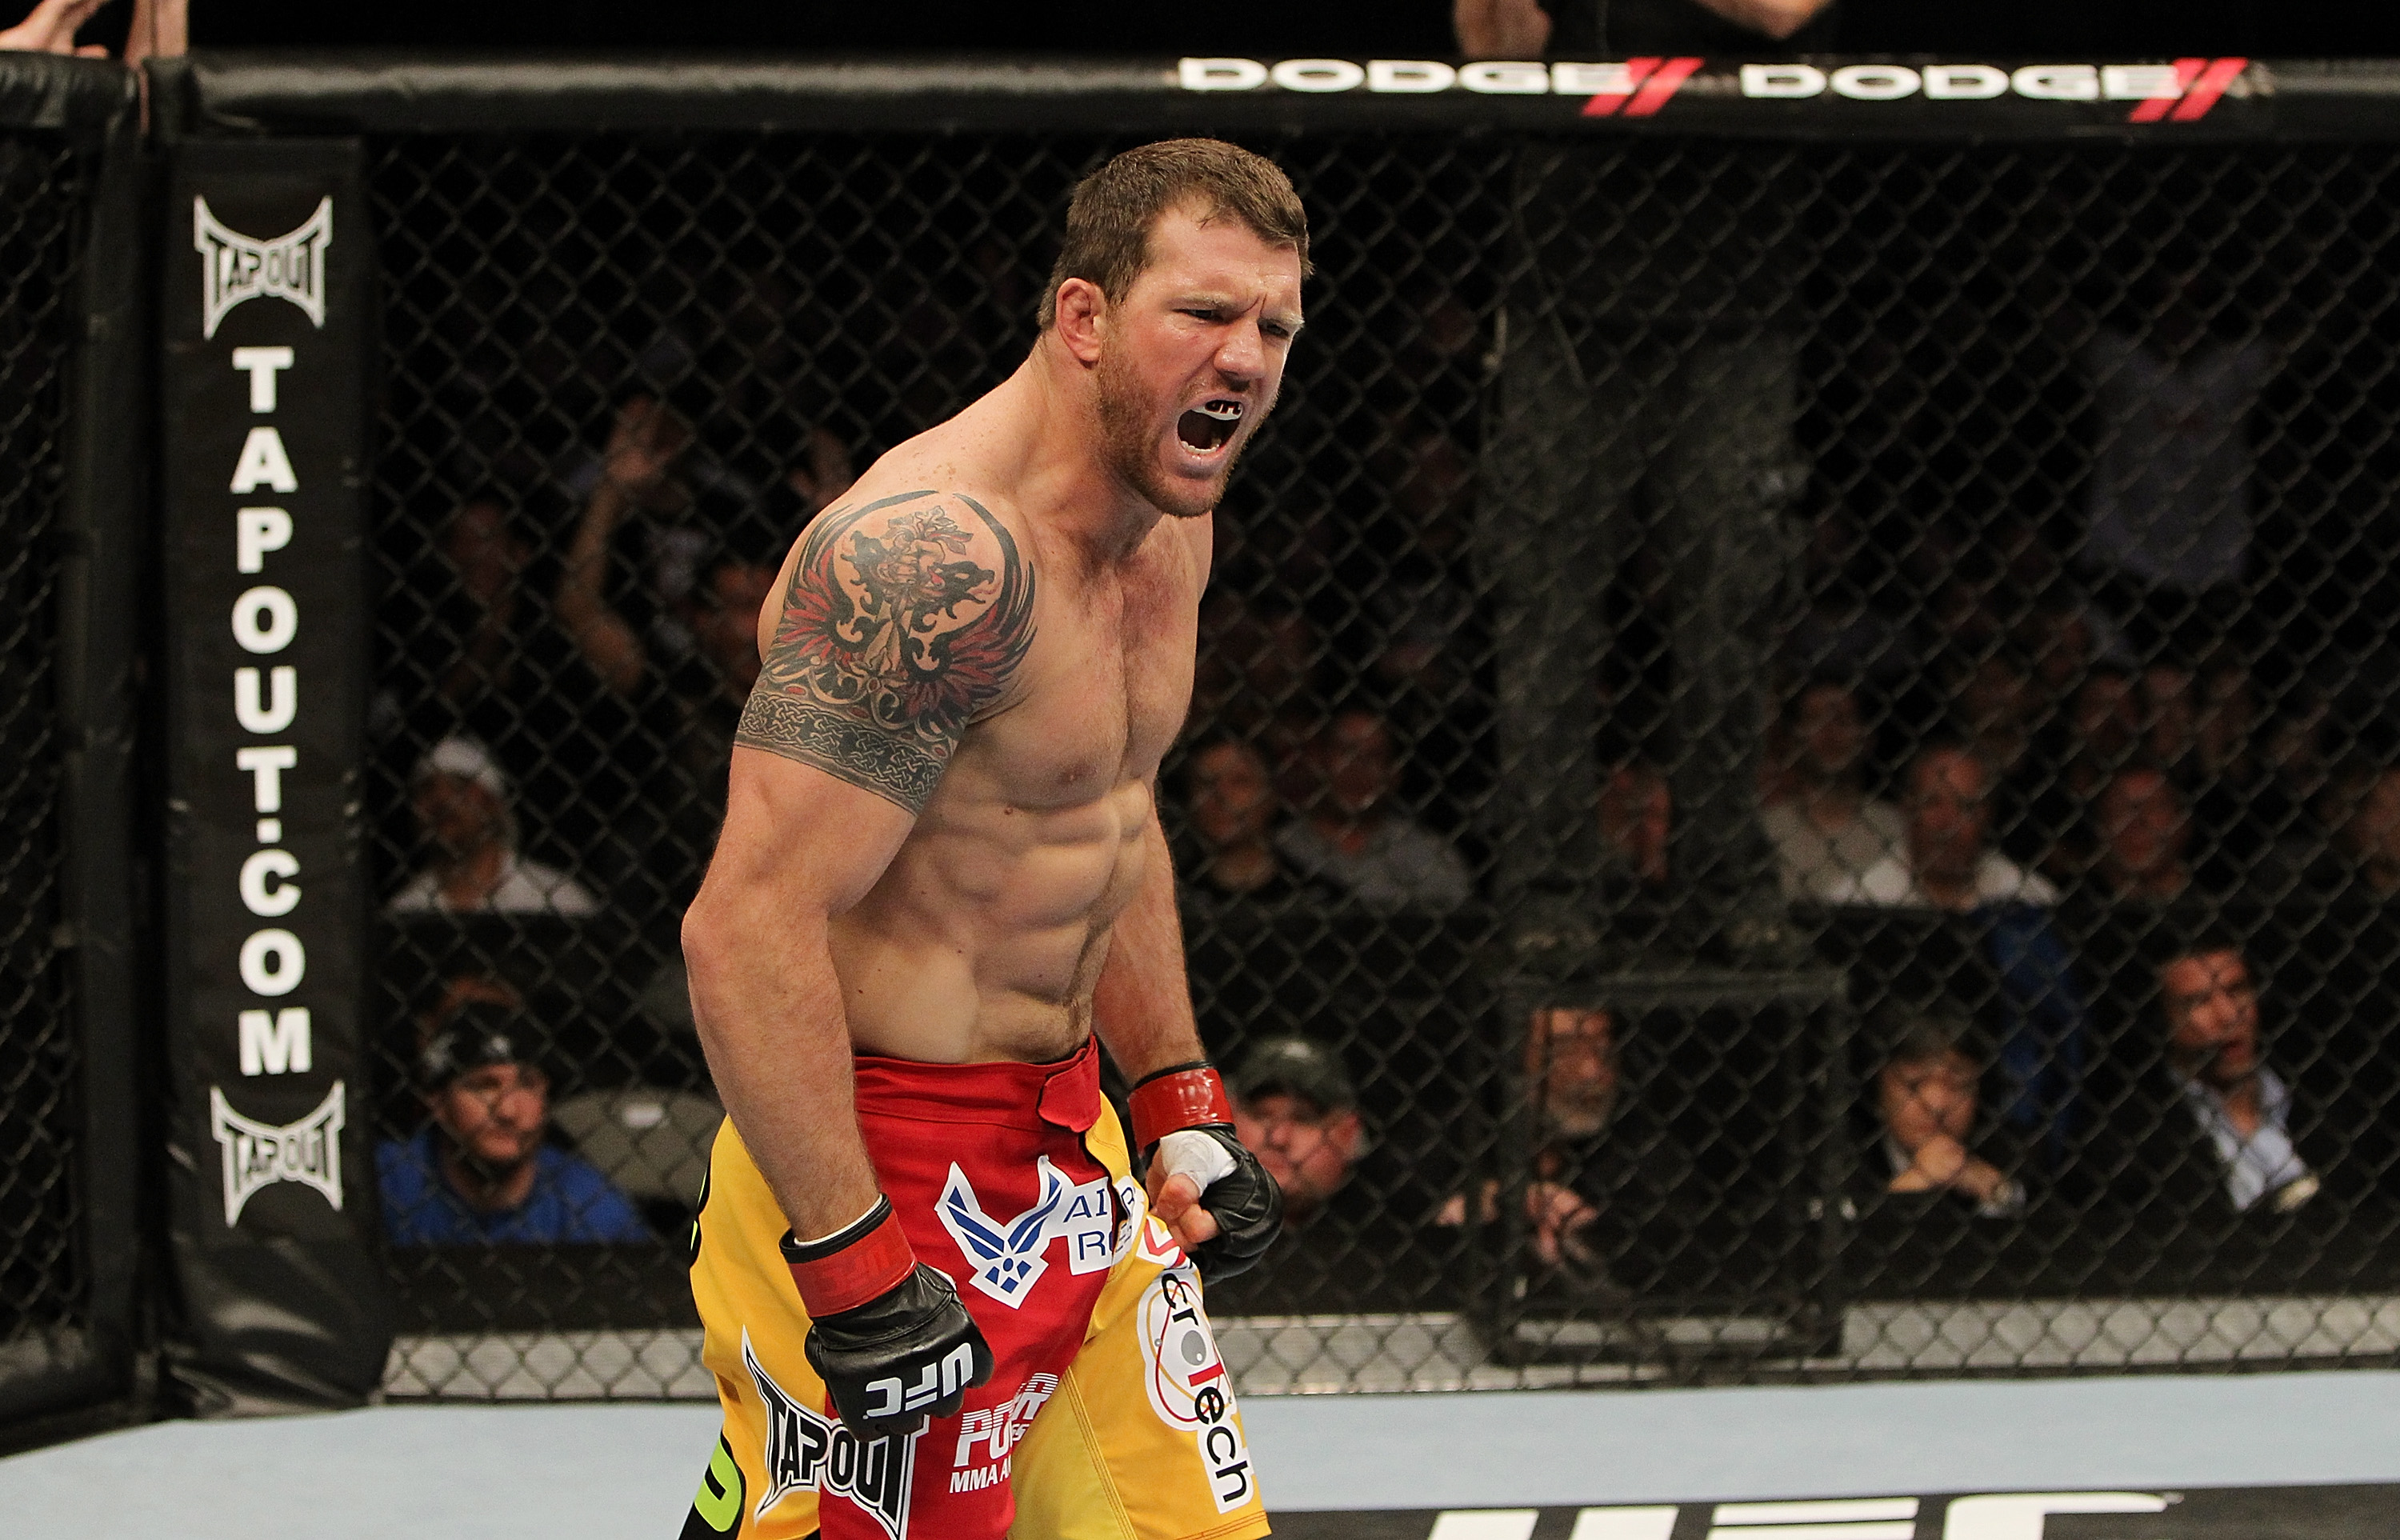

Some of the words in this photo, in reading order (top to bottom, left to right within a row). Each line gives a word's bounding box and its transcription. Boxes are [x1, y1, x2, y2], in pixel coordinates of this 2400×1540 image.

[1178, 57, 1635, 94] DODGE
[1740, 63, 2182, 100] DODGE
[194, 195, 333, 341] TAPOUT
[230, 346, 313, 1076] TAPOUT.COM
[210, 1079, 346, 1229] TAPOUT
[866, 1342, 974, 1418] UFC
[949, 1463, 998, 1494] MMA
